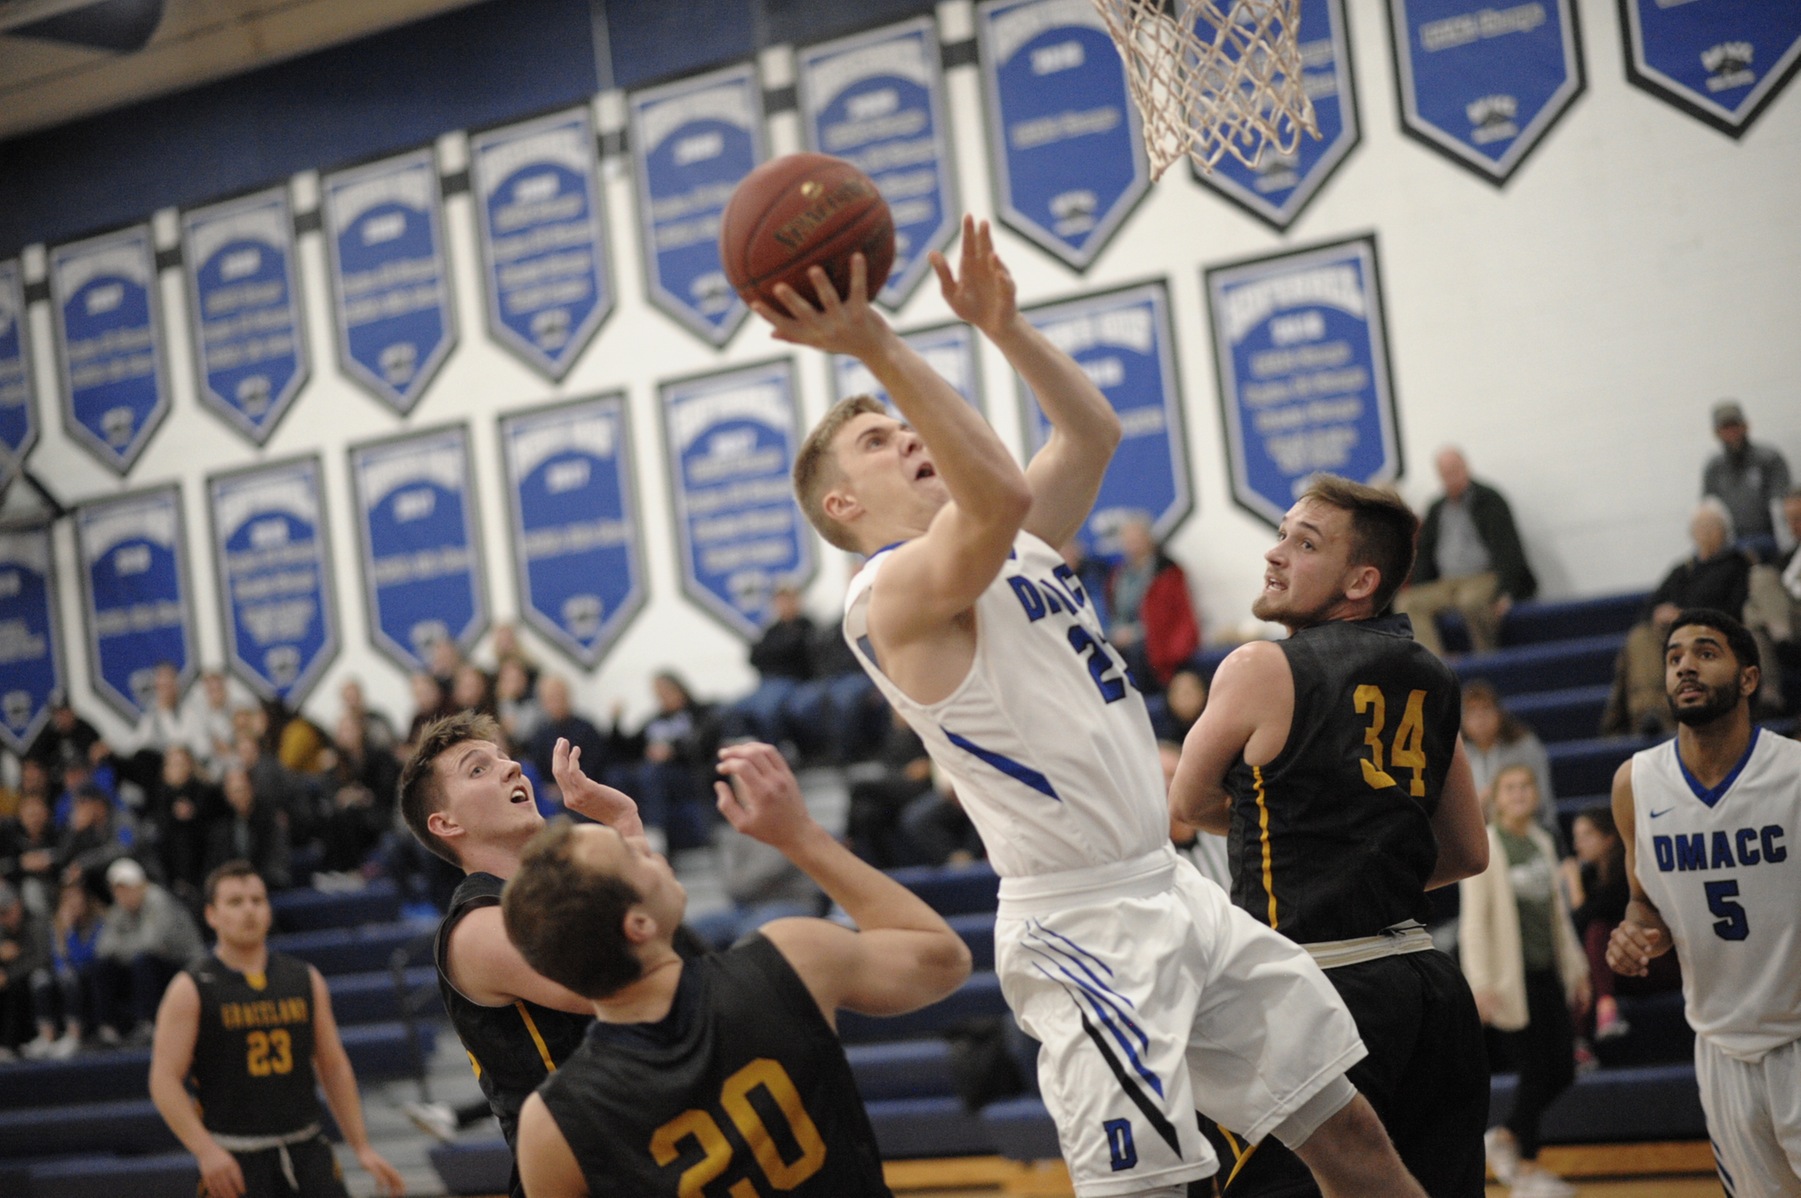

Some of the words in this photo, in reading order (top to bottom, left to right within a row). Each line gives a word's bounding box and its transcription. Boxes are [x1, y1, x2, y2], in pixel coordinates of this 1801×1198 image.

[1352, 684, 1428, 798] 34
[1653, 824, 1788, 872] DMACC
[1703, 879, 1750, 942] 5
[246, 1028, 294, 1077] 23
[649, 1057, 828, 1198] 20
[1102, 1117, 1139, 1172] D
